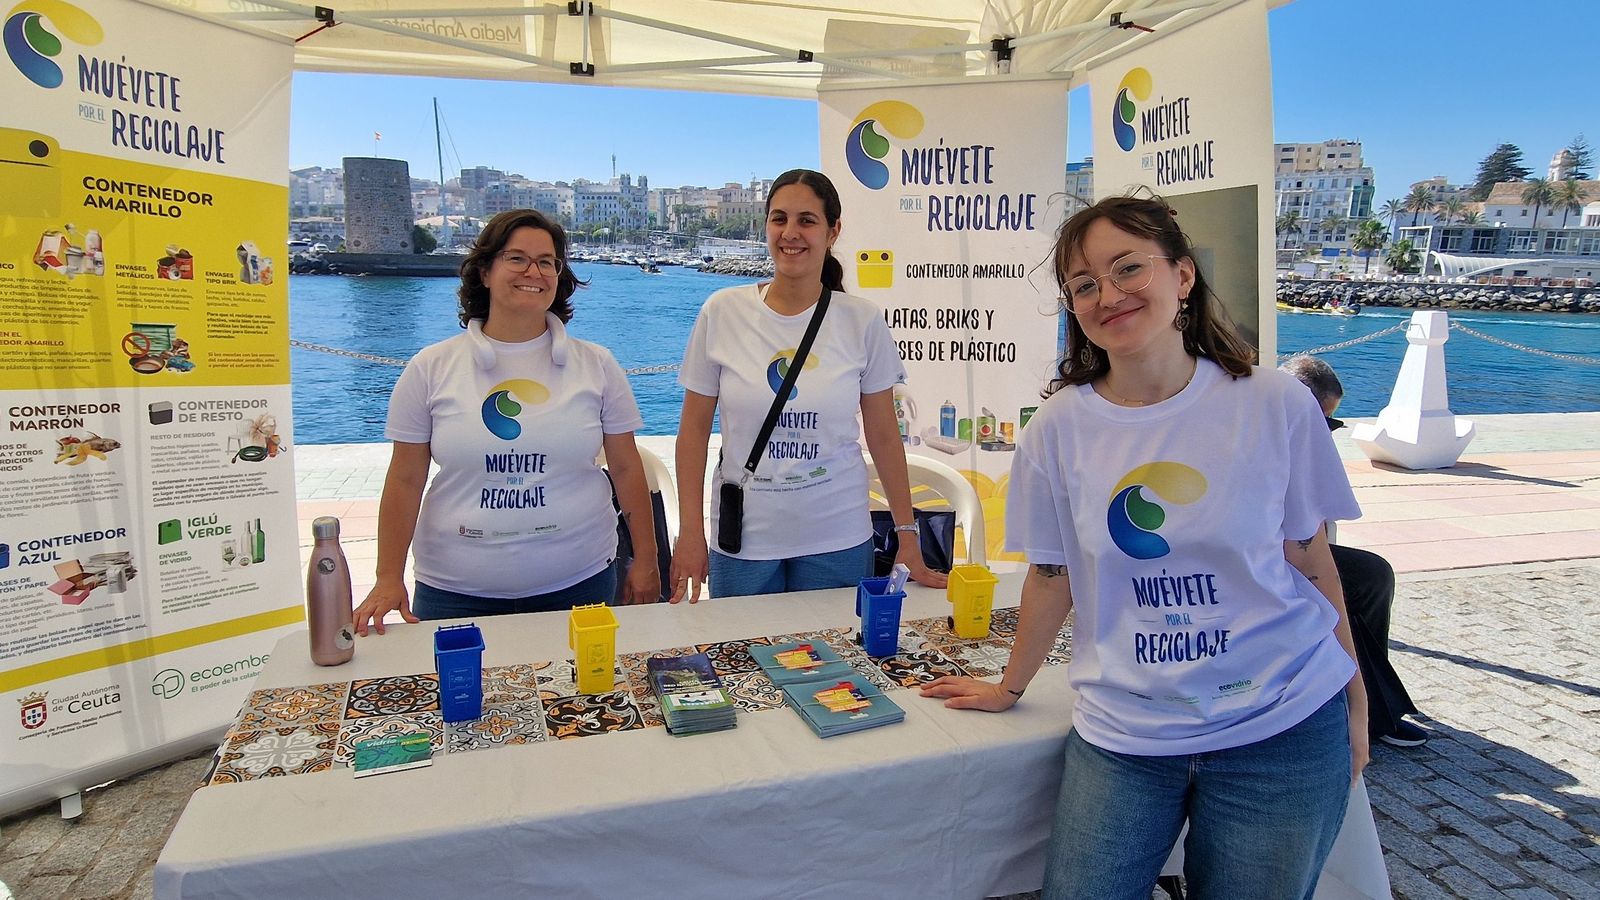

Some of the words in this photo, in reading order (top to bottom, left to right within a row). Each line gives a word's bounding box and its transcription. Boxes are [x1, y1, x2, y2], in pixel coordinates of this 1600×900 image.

[78, 54, 182, 112] MUÉVETE
[78, 104, 95, 120] POR
[97, 108, 106, 122] EL
[1142, 96, 1190, 144] MUÉVETE
[112, 108, 226, 164] RECICLAJE
[900, 138, 995, 186] MUÉVETE
[1156, 140, 1214, 186] RECICLAJE
[82, 176, 214, 206] CONTENEDOR
[83, 194, 182, 218] AMARILLO
[900, 198, 914, 210] POR
[915, 198, 922, 210] EL
[927, 193, 1036, 232] RECICLAJE
[116, 270, 154, 279] METÁLICOS
[906, 264, 969, 278] CONTENEDOR
[972, 264, 1025, 279] AMARILLO
[884, 308, 931, 330] LATAS,
[936, 308, 980, 330] BRIKS
[985, 309, 994, 330] Y
[928, 340, 945, 362] DE
[950, 336, 1016, 363] PLÁSTICO
[8, 403, 120, 417] CONTENEDOR
[178, 400, 268, 411] CONTENEDOR
[10, 416, 84, 432] MARRÓN
[179, 414, 197, 422] DE
[201, 412, 243, 422] RESTO
[485, 448, 547, 473] MUÉVETE
[768, 441, 820, 460] RECICLAJE
[480, 486, 546, 510] RECICLAJE
[188, 513, 218, 528] IGLÚ
[17, 528, 126, 552] CONTENEDOR
[188, 525, 232, 540] VERDE
[18, 550, 61, 566] AZUL
[159, 551, 188, 559] ENVASES
[25, 581, 48, 589] PAPEL
[1132, 568, 1220, 608] MUÉVETE
[1165, 613, 1182, 626] POR
[1184, 613, 1193, 625] EL
[1135, 630, 1231, 665] RECICLAJE
[190, 654, 270, 682] ecoembe
[51, 694, 81, 705] Ciudad
[81, 683, 120, 699] Autónoma
[200, 681, 220, 691] poder
[53, 705, 64, 713] de
[68, 691, 121, 714] Ceuta
[366, 738, 397, 747] vidrio
